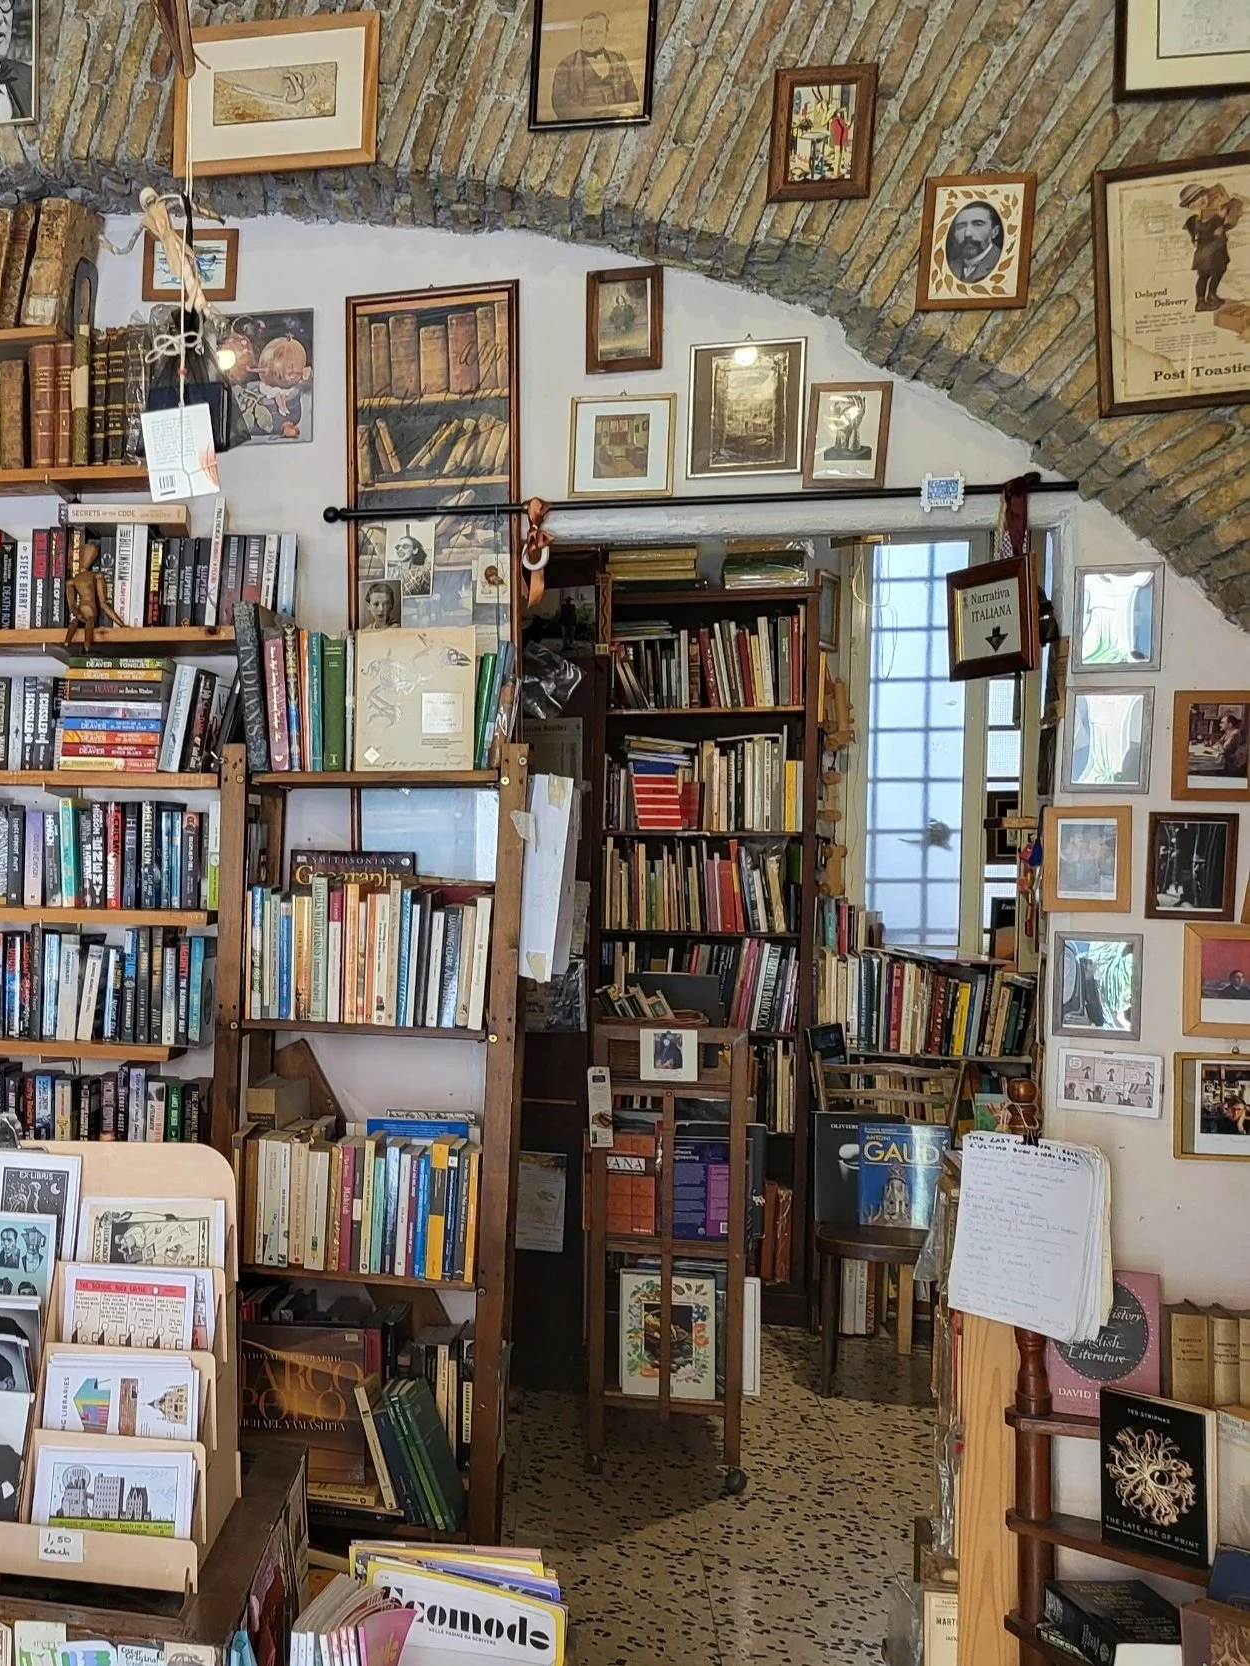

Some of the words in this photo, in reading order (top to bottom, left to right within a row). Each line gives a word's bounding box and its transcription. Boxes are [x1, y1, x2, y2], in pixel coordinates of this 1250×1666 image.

[1134, 288, 1167, 299] Delayed
[1154, 298, 1188, 308] Delivery
[1153, 369, 1185, 382] Post
[19, 555, 29, 580] STEVE
[118, 538, 130, 581] BILLINGHAM
[248, 561, 257, 587] IMPACT
[2, 585, 11, 611] DEATH
[18, 583, 28, 608] BERRY
[971, 587, 1010, 605] Narrativa
[972, 606, 1012, 623] ITALIANA
[240, 644, 258, 736] INDIANS
[24, 698, 34, 733] CUSSLER
[37, 698, 48, 733] CUSSLER
[78, 746, 105, 755] DEAVER
[92, 804, 100, 835] HIGSON
[126, 818, 136, 851] HILL
[144, 832, 152, 864] HILTON
[92, 839, 103, 891] ENEMY
[312, 856, 396, 866] SMITHSONIAN
[107, 863, 115, 899] HIGSON
[863, 1140, 949, 1164] GAUDÍ
[1111, 1309, 1145, 1325] istory
[1067, 1347, 1132, 1363] Literature
[243, 1360, 364, 1392] ARCO
[60, 1376, 70, 1417] LIBRARIES
[242, 1389, 346, 1421] POLO
[1058, 1387, 1092, 1399] DAVID
[240, 1419, 282, 1430] ICHAEL
[284, 1420, 346, 1432] YAMASHITA
[1140, 1409, 1171, 1425] STRIPHAS
[46, 1535, 72, 1545] 1,50
[1106, 1515, 1121, 1526] THE
[1123, 1518, 1144, 1532] LATE
[1145, 1526, 1159, 1536] AGE
[1161, 1529, 1172, 1540] OF
[1174, 1535, 1200, 1550] PRINT
[43, 1547, 71, 1557] each
[428, 1626, 444, 1634] NELLE
[444, 1629, 463, 1639] PAGINE
[472, 1635, 497, 1646] SCRIVERE
